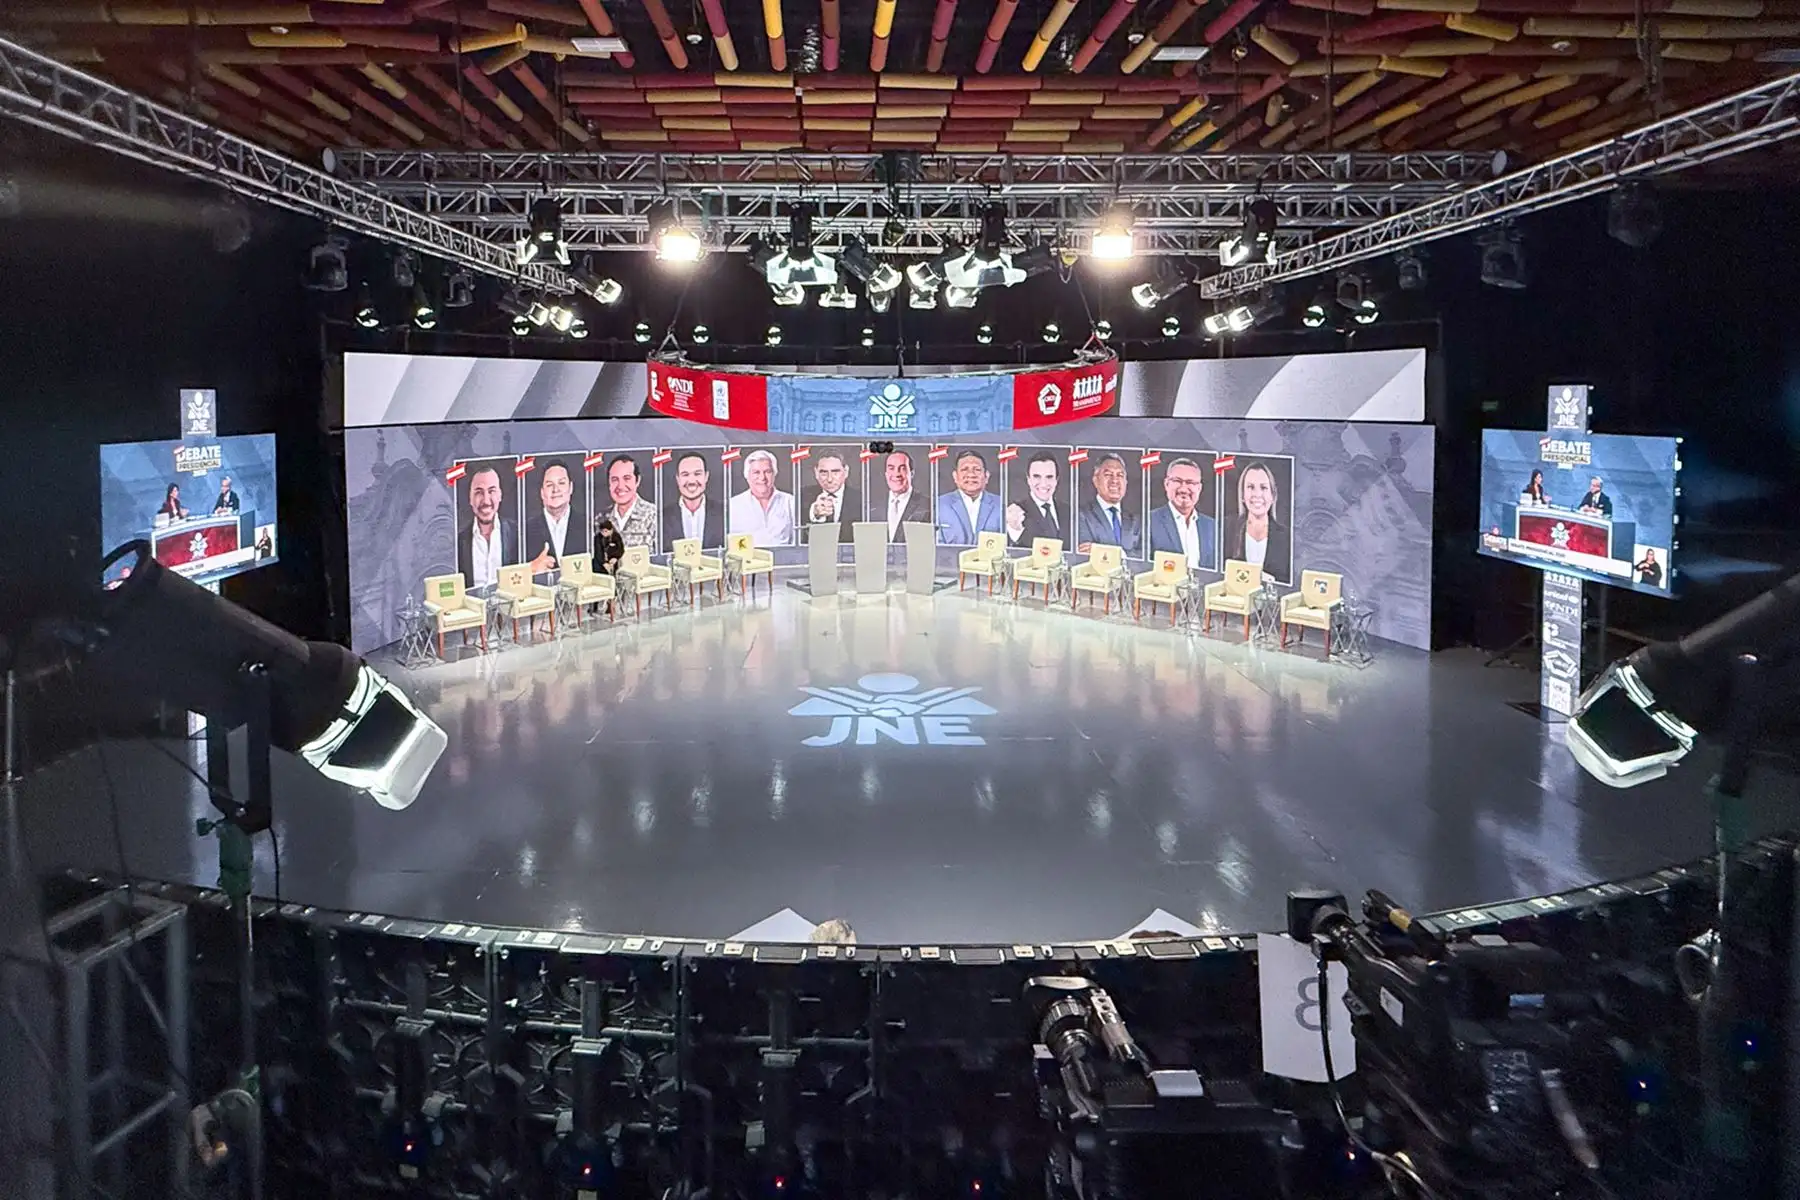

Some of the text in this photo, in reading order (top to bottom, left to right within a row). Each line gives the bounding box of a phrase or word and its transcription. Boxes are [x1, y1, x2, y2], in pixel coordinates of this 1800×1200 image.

[874, 414, 909, 429] JNE
[175, 445, 221, 462] DEBATE
[1540, 440, 1592, 455] DEBATE
[801, 716, 986, 747] JNE
